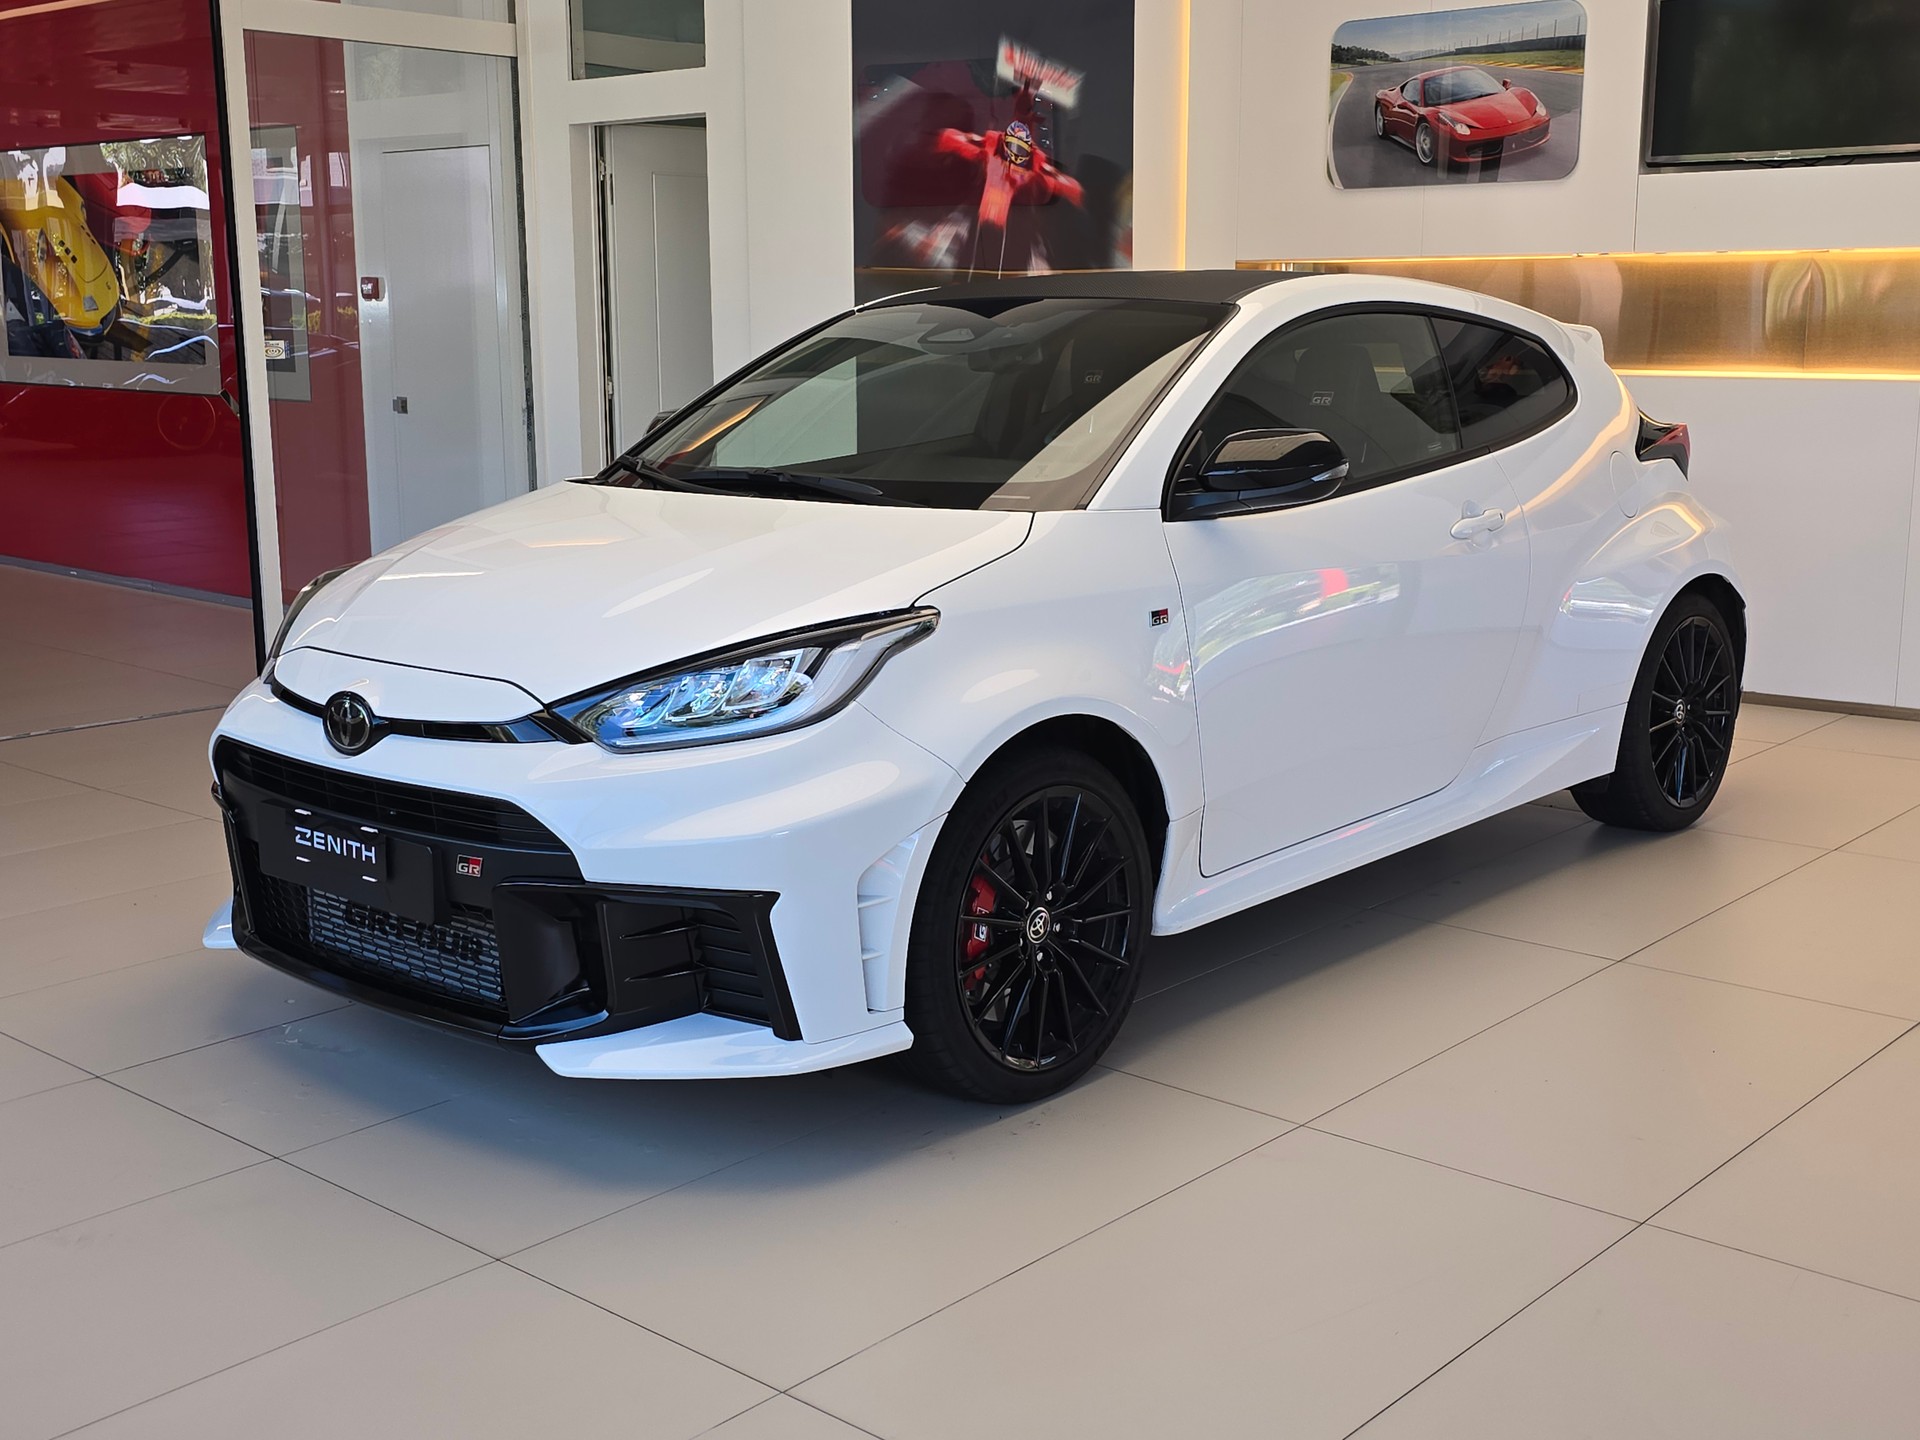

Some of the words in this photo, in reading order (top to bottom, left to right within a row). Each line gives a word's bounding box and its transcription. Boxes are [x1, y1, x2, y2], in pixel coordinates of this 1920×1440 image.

[1312, 396, 1331, 405] GR
[294, 825, 376, 864] ZENITH
[458, 862, 480, 874] GR
